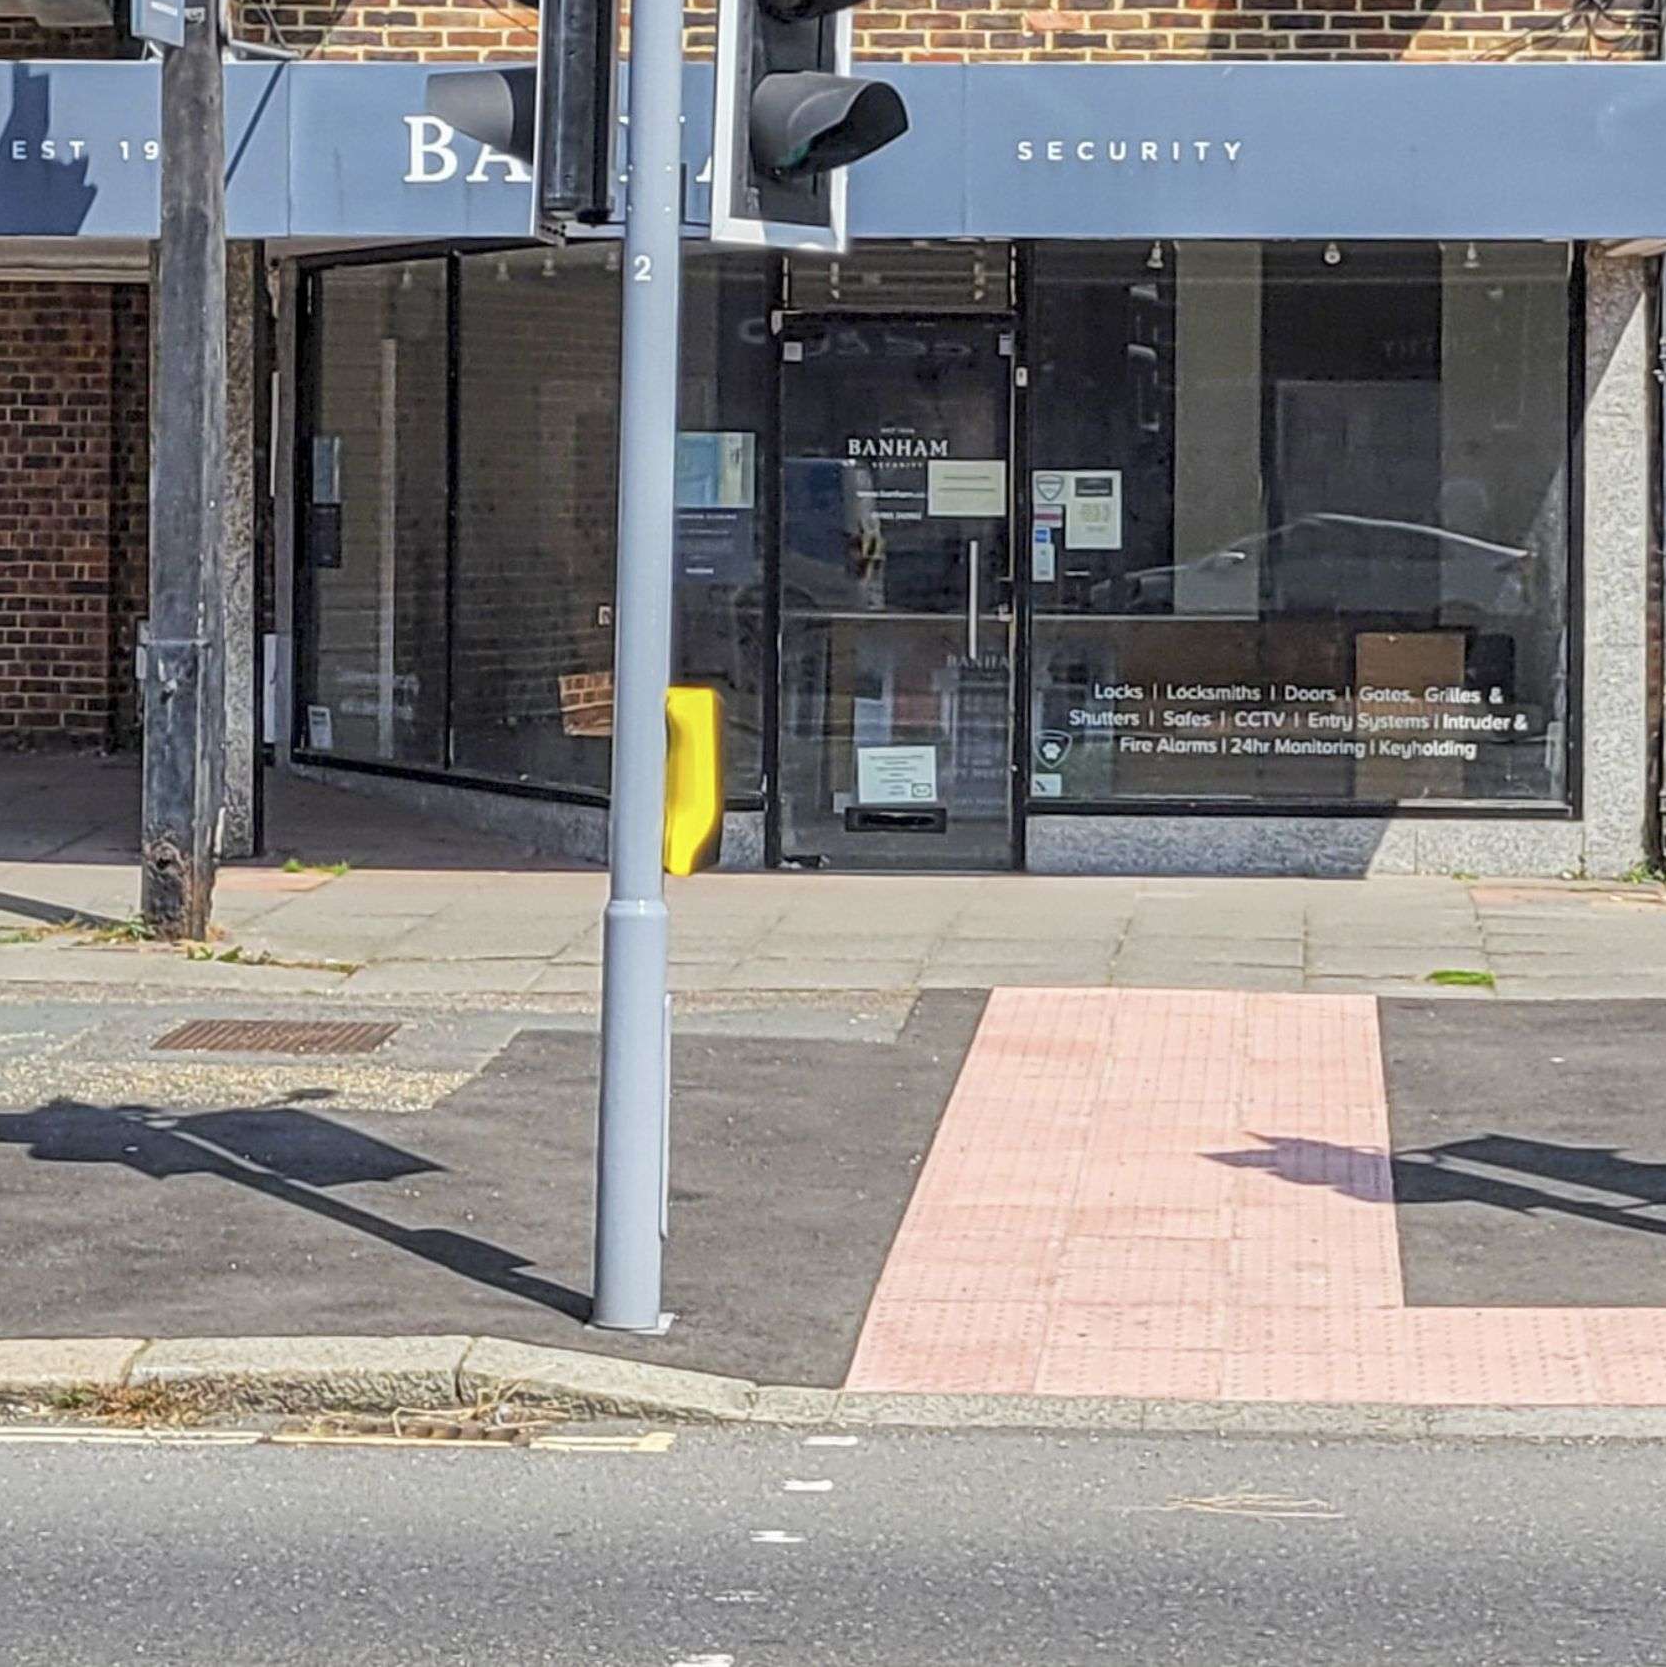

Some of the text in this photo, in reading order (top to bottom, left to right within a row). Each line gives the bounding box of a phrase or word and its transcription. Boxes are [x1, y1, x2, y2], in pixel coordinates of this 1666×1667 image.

[12, 140, 160, 160] EST 19
[1017, 141, 1242, 161] SECURITY
[634, 254, 652, 282] 2
[848, 438, 948, 457] BANHAM
[1094, 683, 1144, 700] Locks
[1166, 683, 1261, 701] Locksmiths
[1284, 685, 1336, 702] Doors
[1424, 686, 1482, 704] Grilles
[1489, 687, 1503, 704] &
[1069, 709, 1528, 732] Shutters Safes CCTV Entry Systems Intruder &
[1120, 736, 1477, 760] Fire Alarms 24hr Monitoring Keyholding
